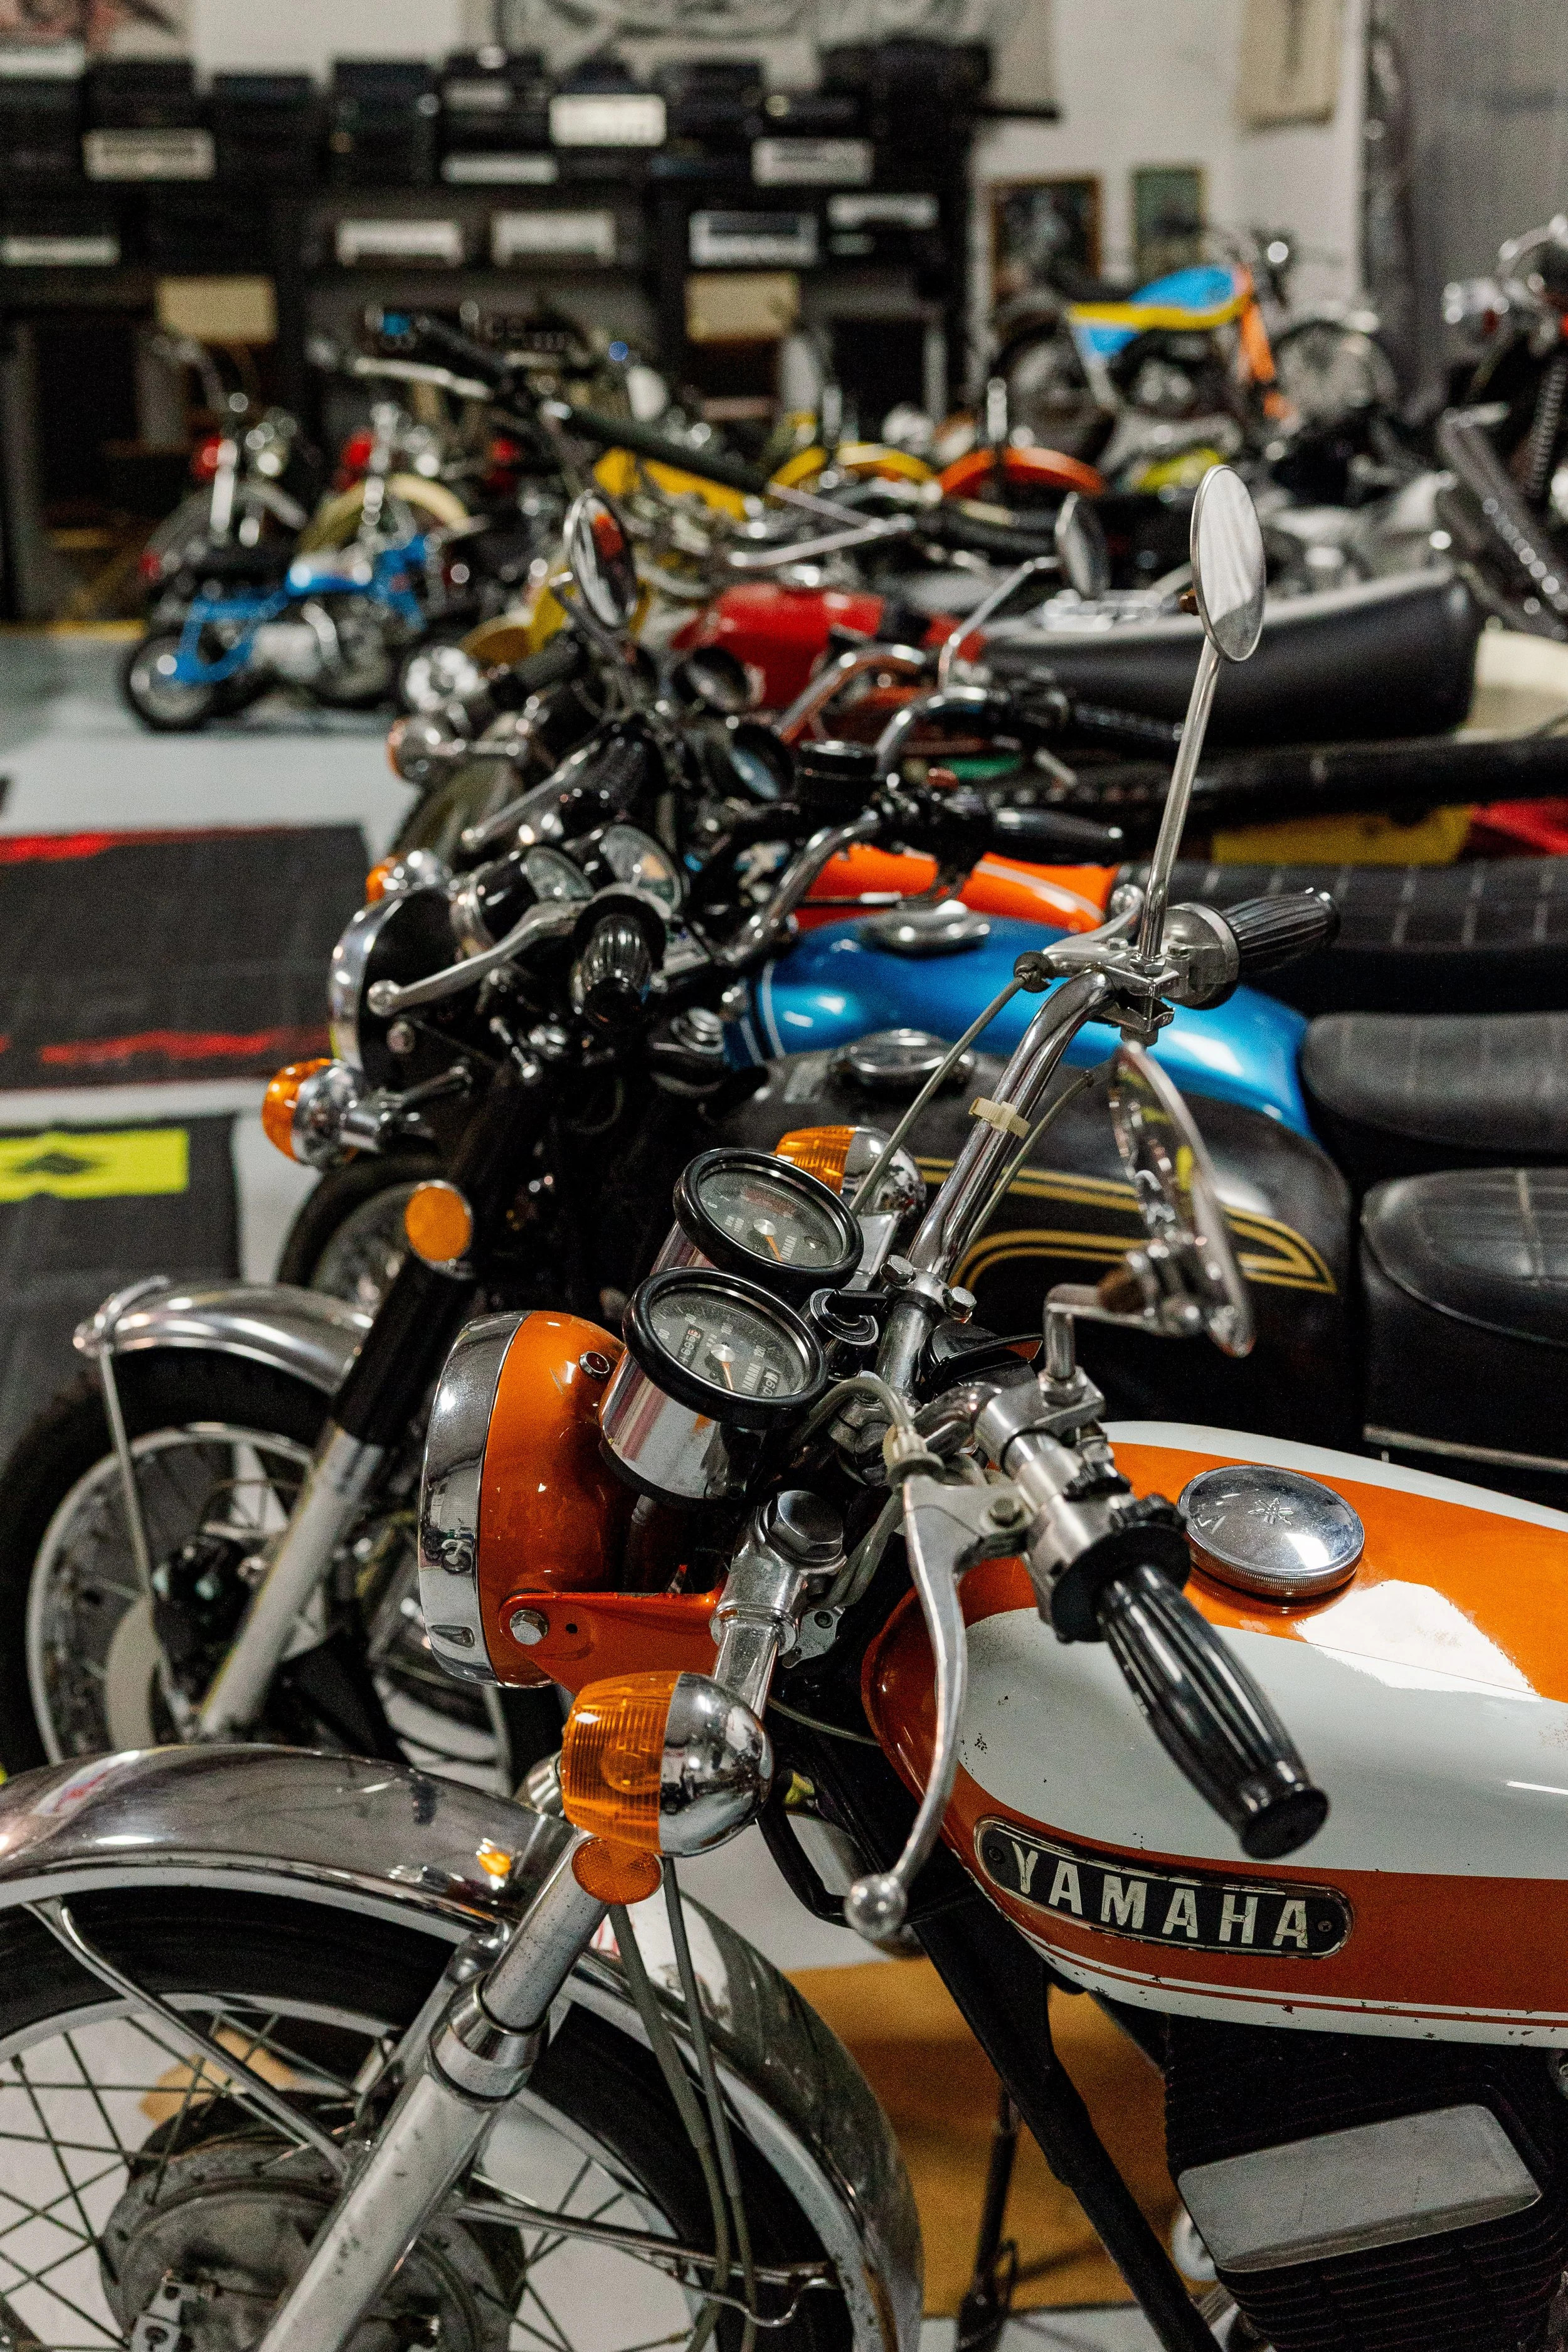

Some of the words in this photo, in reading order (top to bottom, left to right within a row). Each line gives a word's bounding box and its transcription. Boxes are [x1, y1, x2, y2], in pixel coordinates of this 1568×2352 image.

[780, 1235, 798, 1260] YAMAHA
[657, 1328, 670, 1340] 60
[753, 1344, 766, 1358] 120
[741, 1362, 761, 1391] YAMAHA
[1011, 1841, 1310, 1949] YAMAHA
